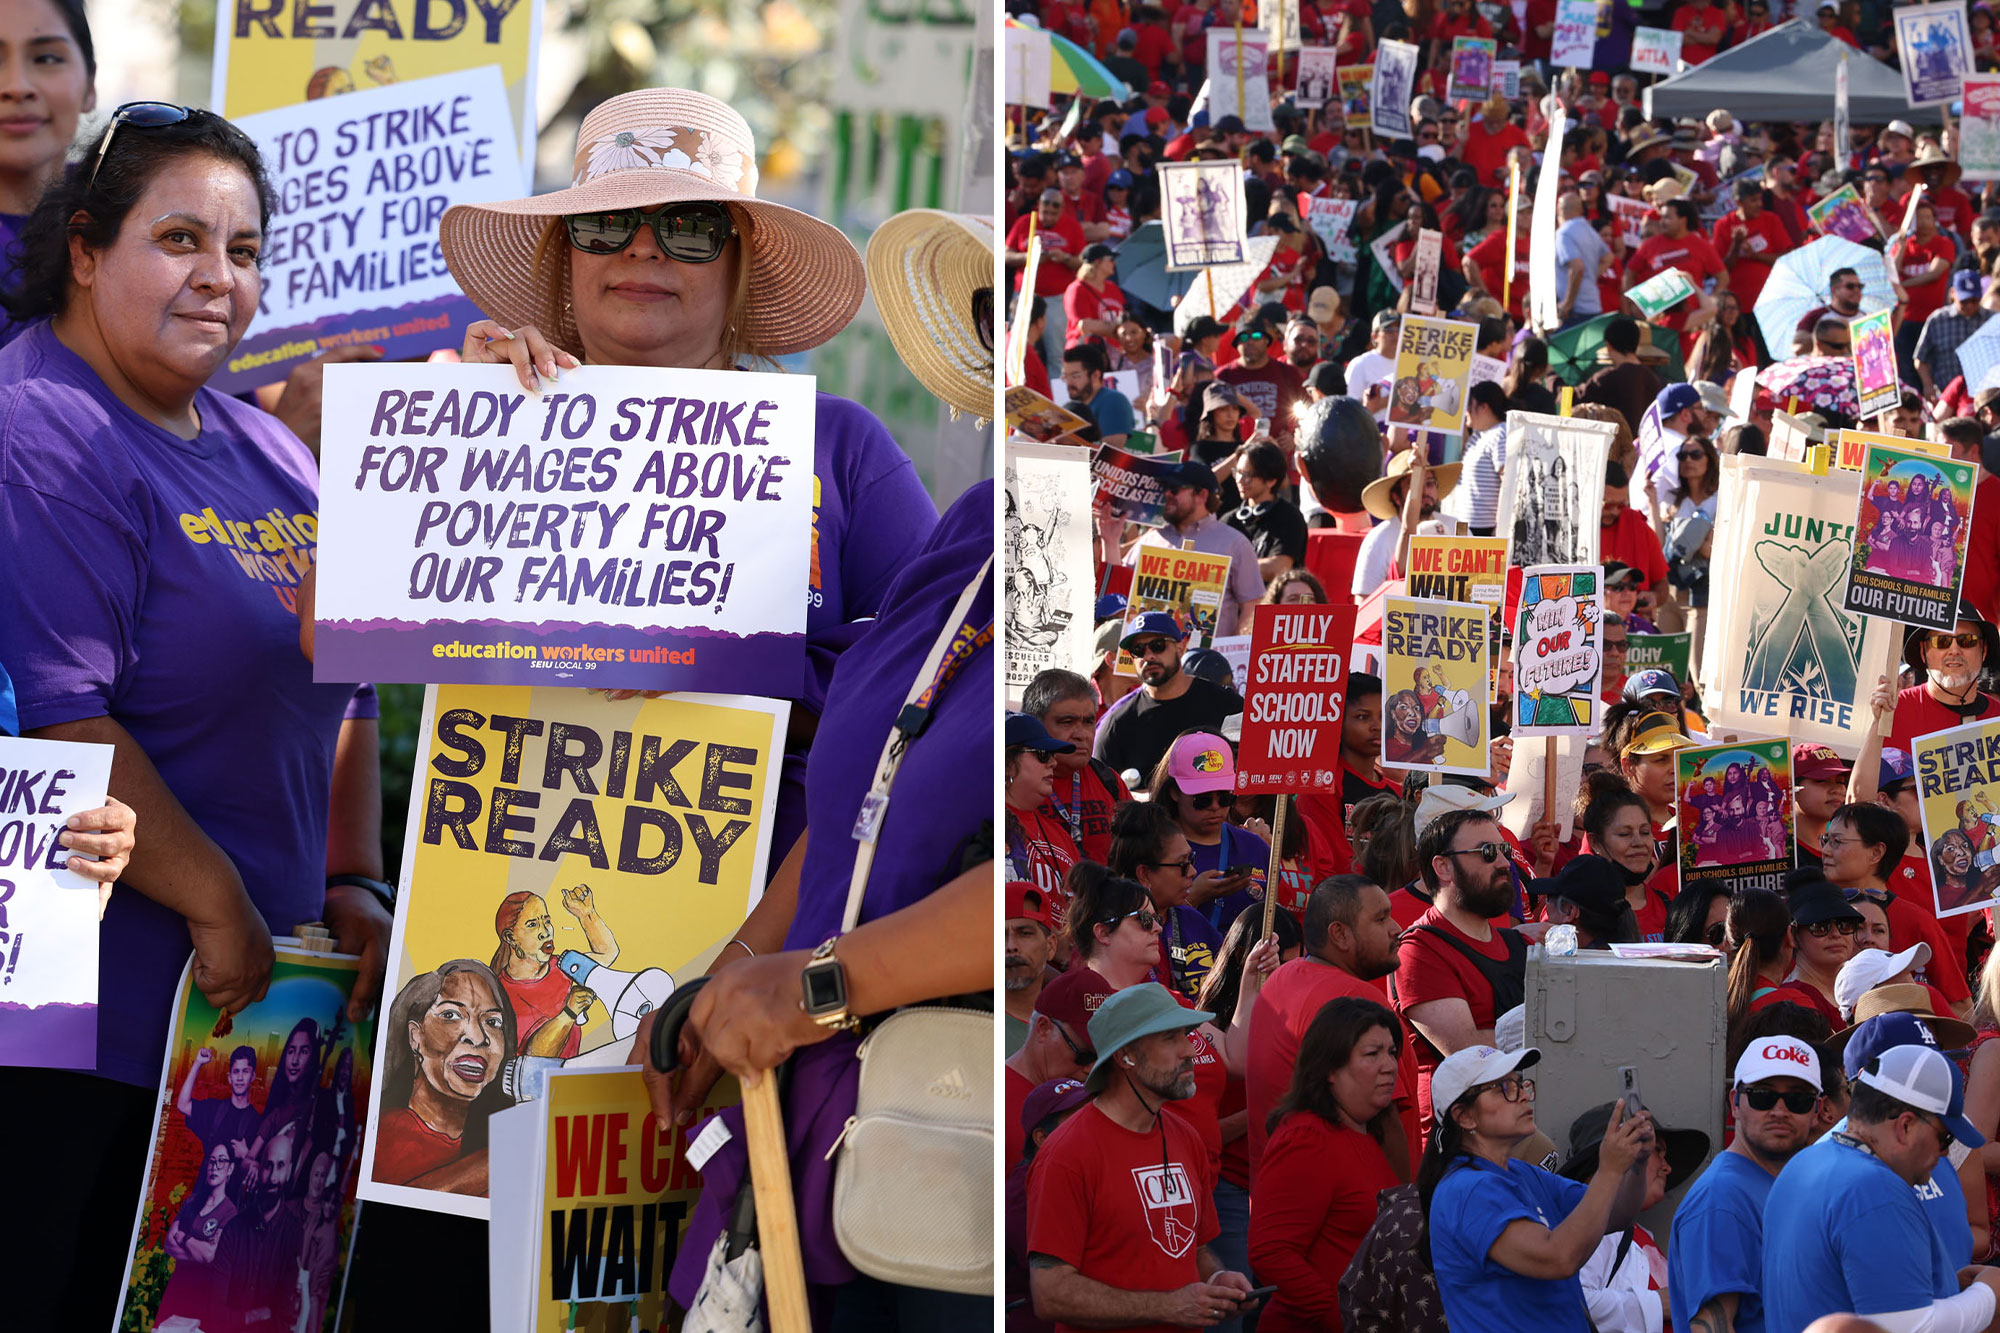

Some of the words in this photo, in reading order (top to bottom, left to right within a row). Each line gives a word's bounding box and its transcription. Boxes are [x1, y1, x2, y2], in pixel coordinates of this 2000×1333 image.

[235, 0, 519, 45] READY
[274, 126, 318, 173] TO
[335, 96, 472, 158] STRIKE
[366, 138, 493, 196] ABOVE
[271, 206, 364, 267] ERTY
[380, 195, 450, 239] FOR
[228, 338, 317, 373] education
[318, 324, 391, 348] workers
[392, 312, 451, 337] united
[1400, 339, 1472, 363] READY
[1402, 324, 1474, 348] STRIKE
[369, 388, 526, 438] READY
[540, 393, 598, 441] TO
[609, 397, 779, 446] STRIKE
[354, 445, 449, 494] FOR
[458, 445, 622, 494] WAGES
[632, 450, 792, 502] ABOVE
[1094, 459, 1140, 487] UNIDOS
[414, 499, 630, 553] POVERTY
[637, 503, 728, 560] FOR
[1140, 555, 1170, 577] WE
[1172, 559, 1226, 585] CAN'T
[1412, 547, 1443, 572] WE
[1448, 548, 1505, 574] CAN'T
[407, 552, 505, 604] OUR
[1137, 575, 1191, 603] WAIT
[1410, 574, 1469, 602] WAIT
[1853, 574, 1869, 584] OUR
[1869, 577, 1903, 592] SCHOOLS.
[1903, 584, 1919, 595] OUR
[1919, 587, 1952, 602] FAMILIES.
[1537, 604, 1567, 632] WIN
[1850, 585, 1884, 610] OUR
[1886, 592, 1949, 623] FUTURE.
[1135, 615, 1146, 630] B
[1271, 614, 1334, 645] FULLY
[1386, 610, 1484, 641] STRIKE
[431, 640, 537, 661] education
[541, 643, 625, 664] workers
[628, 647, 696, 666] united
[1386, 632, 1484, 663] READY
[1537, 630, 1571, 658] OUR
[530, 660, 553, 669] SEIU
[554, 661, 583, 670] LOCAL
[584, 662, 597, 670] 99
[1256, 653, 1342, 684] STAFFED
[1524, 648, 1594, 688] FUTURE!
[1250, 692, 1342, 723] SCHOOLS
[1740, 690, 1780, 716] WE
[1789, 694, 1853, 730] RISE
[1267, 728, 1317, 759] NOW
[1918, 733, 2000, 775] STRIK
[431, 708, 759, 816] STRIKE
[1250, 774, 1266, 784] UTLA
[1921, 758, 2000, 799] READ
[422, 778, 753, 886] READY
[1685, 871, 1701, 882] OUR
[1702, 868, 1738, 879] SCHOOLS.
[1738, 866, 1754, 876] OUR
[1755, 861, 1790, 874] FAMILIES.
[1914, 1020, 1937, 1045] LA
[1762, 1044, 1811, 1068] Coke
[554, 1111, 630, 1199] WE
[551, 1200, 688, 1301] WAIT
